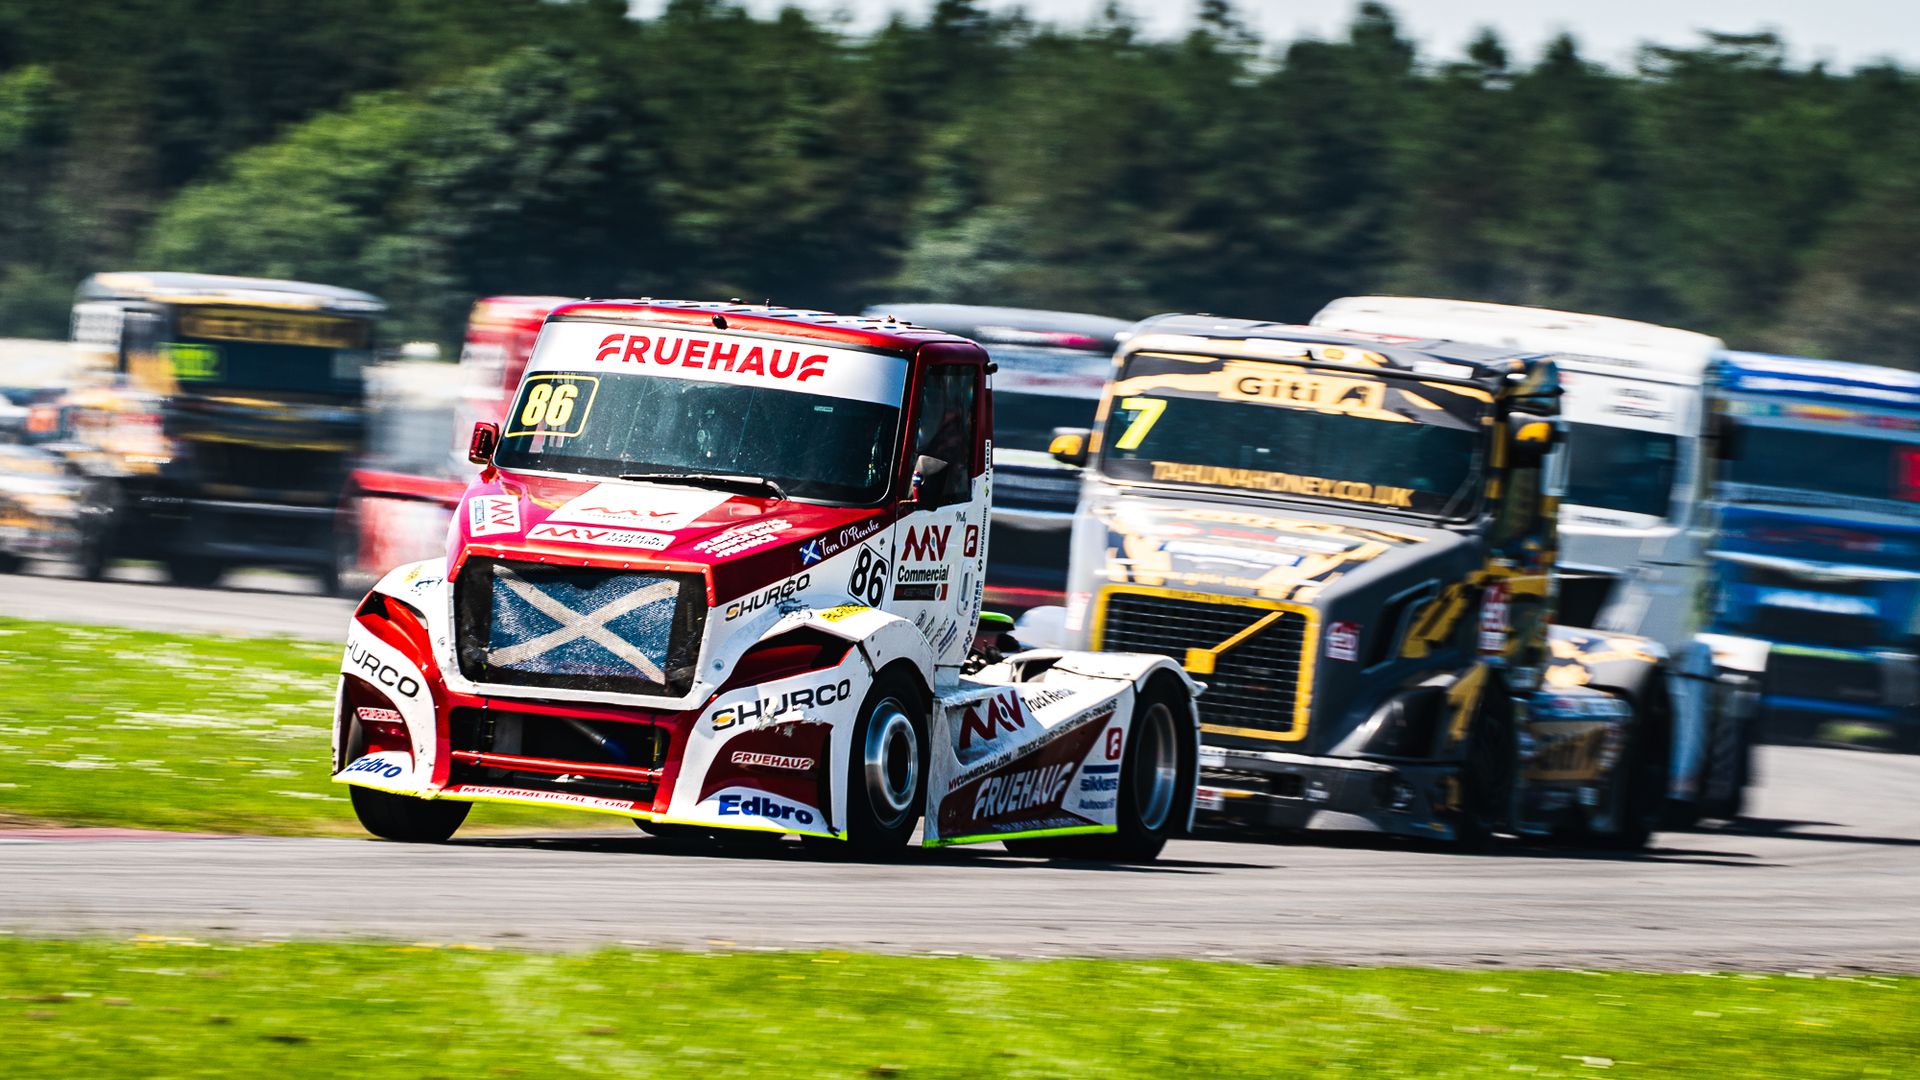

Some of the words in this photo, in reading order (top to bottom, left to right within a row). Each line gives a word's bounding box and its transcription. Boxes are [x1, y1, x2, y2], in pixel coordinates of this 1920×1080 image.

[595, 333, 829, 382] FRUEHAUF
[521, 383, 579, 427] 86
[1238, 376, 1318, 402] Giti
[1115, 398, 1167, 450] 7
[818, 537, 841, 557] Tom
[901, 525, 952, 561] MV
[851, 547, 887, 608] 86
[897, 564, 950, 583] Commercial
[725, 573, 810, 622] SHURCO
[711, 678, 849, 731] SHURCO
[959, 690, 1026, 750] MV
[1020, 690, 1052, 713] Truck
[347, 757, 403, 779] Edbro
[731, 751, 812, 770] FRUEHAUF
[718, 794, 813, 825] Edbro
[972, 761, 1075, 820] FRUEHAUF
